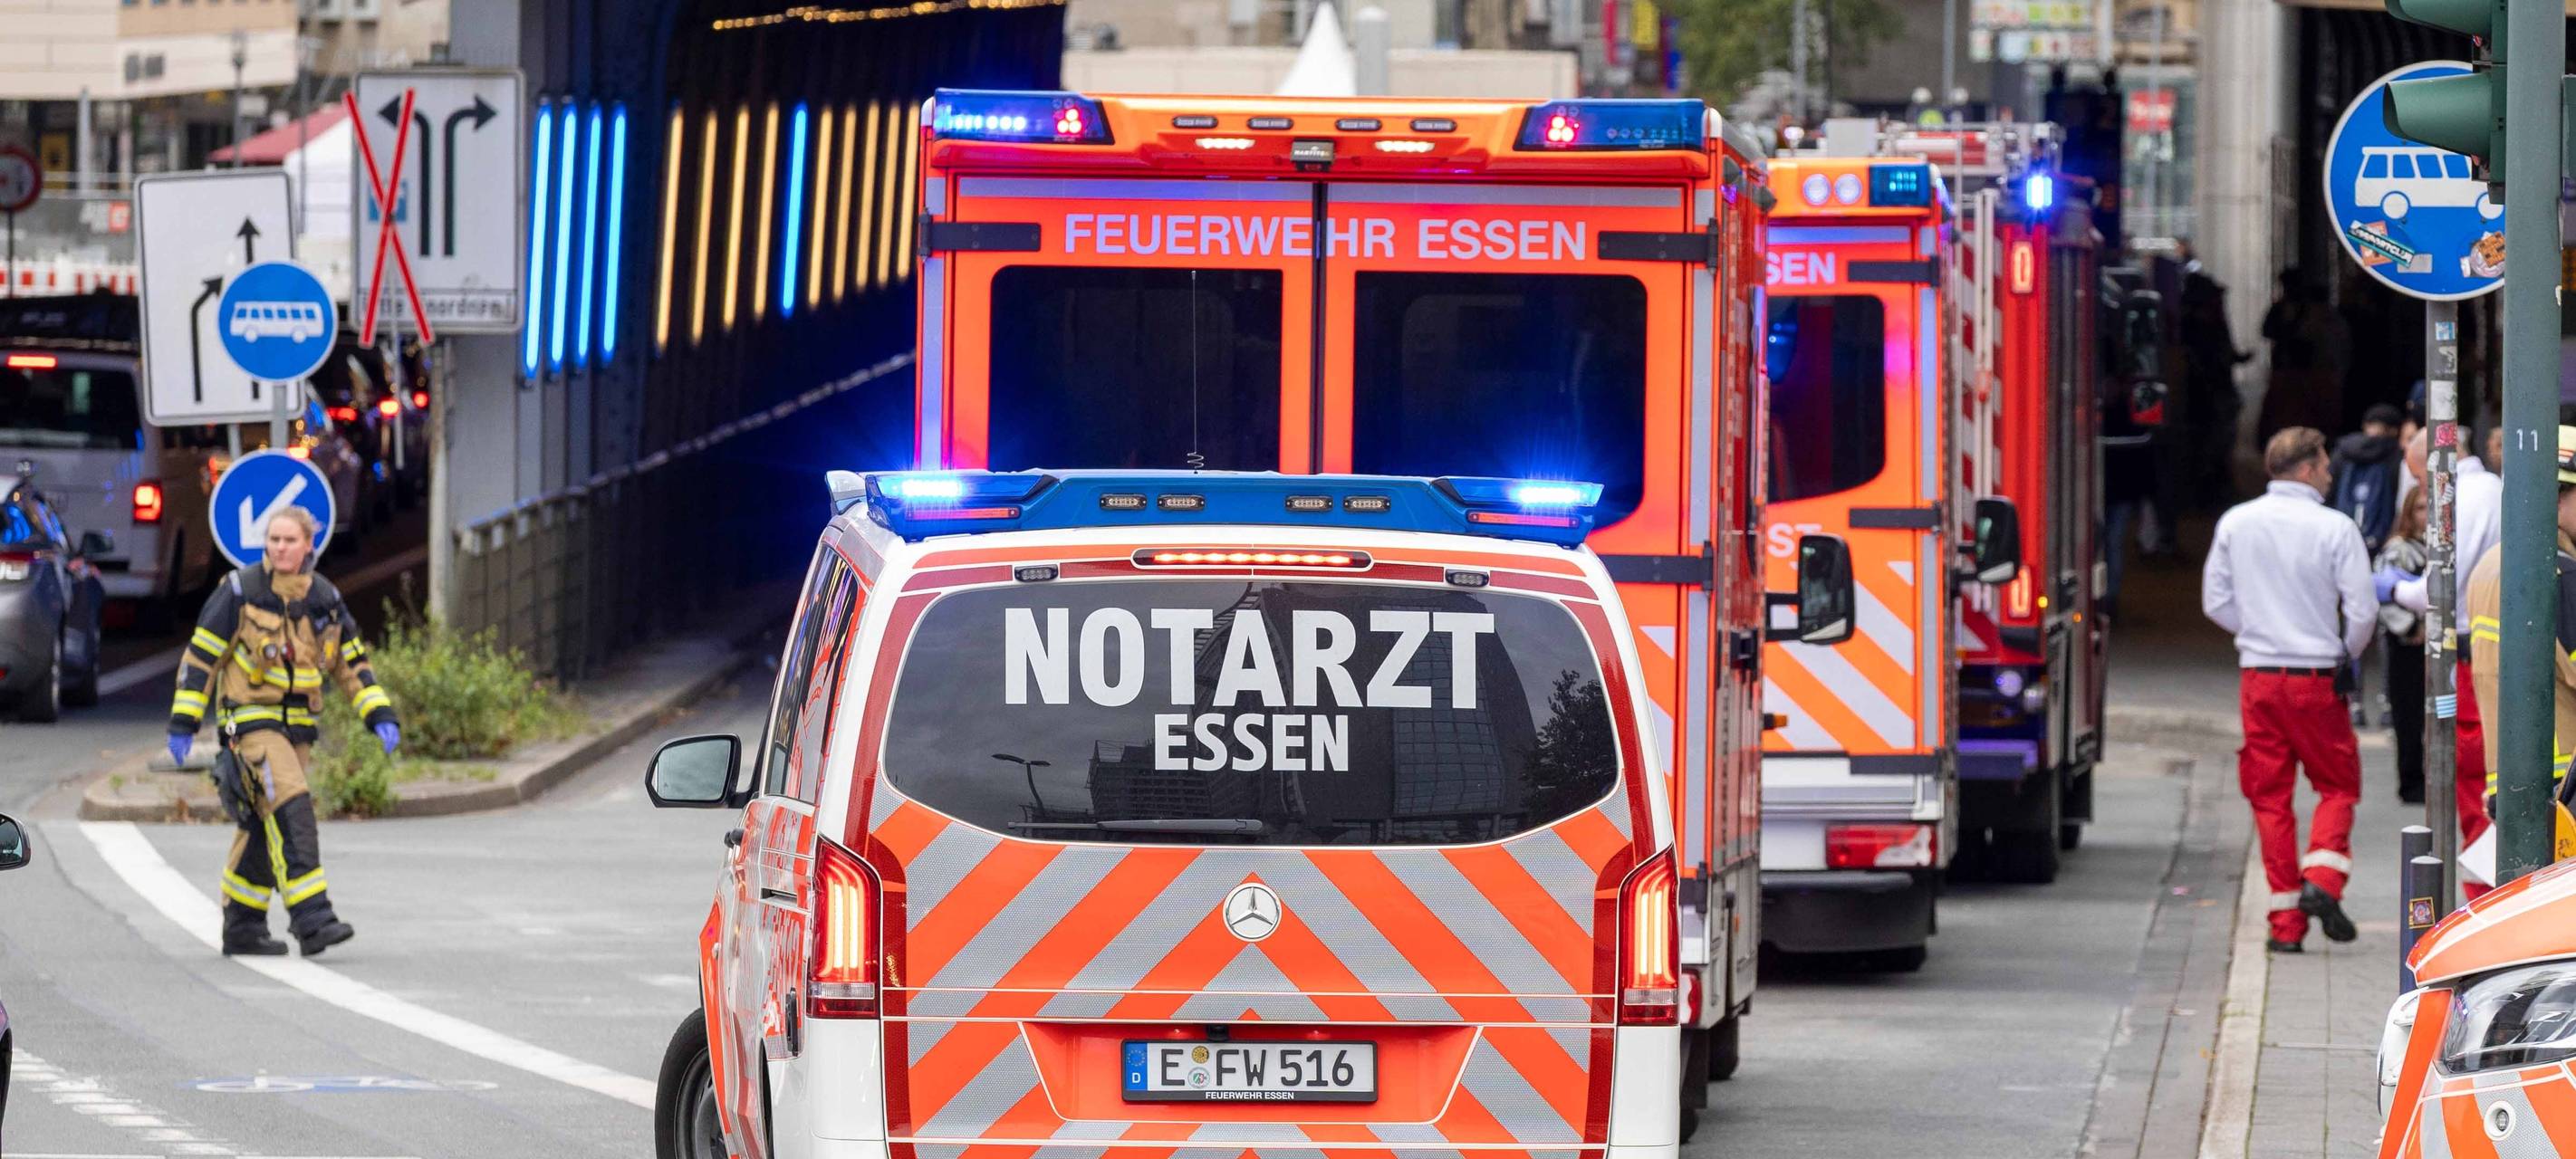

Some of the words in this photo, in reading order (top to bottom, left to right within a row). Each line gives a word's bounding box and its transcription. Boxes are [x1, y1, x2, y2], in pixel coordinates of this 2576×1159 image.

[1065, 213, 1396, 258] FEUERWEHR
[1418, 218, 1586, 261] ESSEN
[2516, 427, 2538, 452] 11
[1004, 607, 1495, 710] NOTARZT
[1154, 713, 1349, 771] ESSEN
[1131, 1072, 1141, 1084] D
[1161, 1049, 1185, 1086] E
[1216, 1049, 1266, 1087] FW
[1280, 1049, 1354, 1087] 516
[1205, 1091, 1263, 1101] FEUERWEHR
[1264, 1091, 1295, 1101] ESSEN
